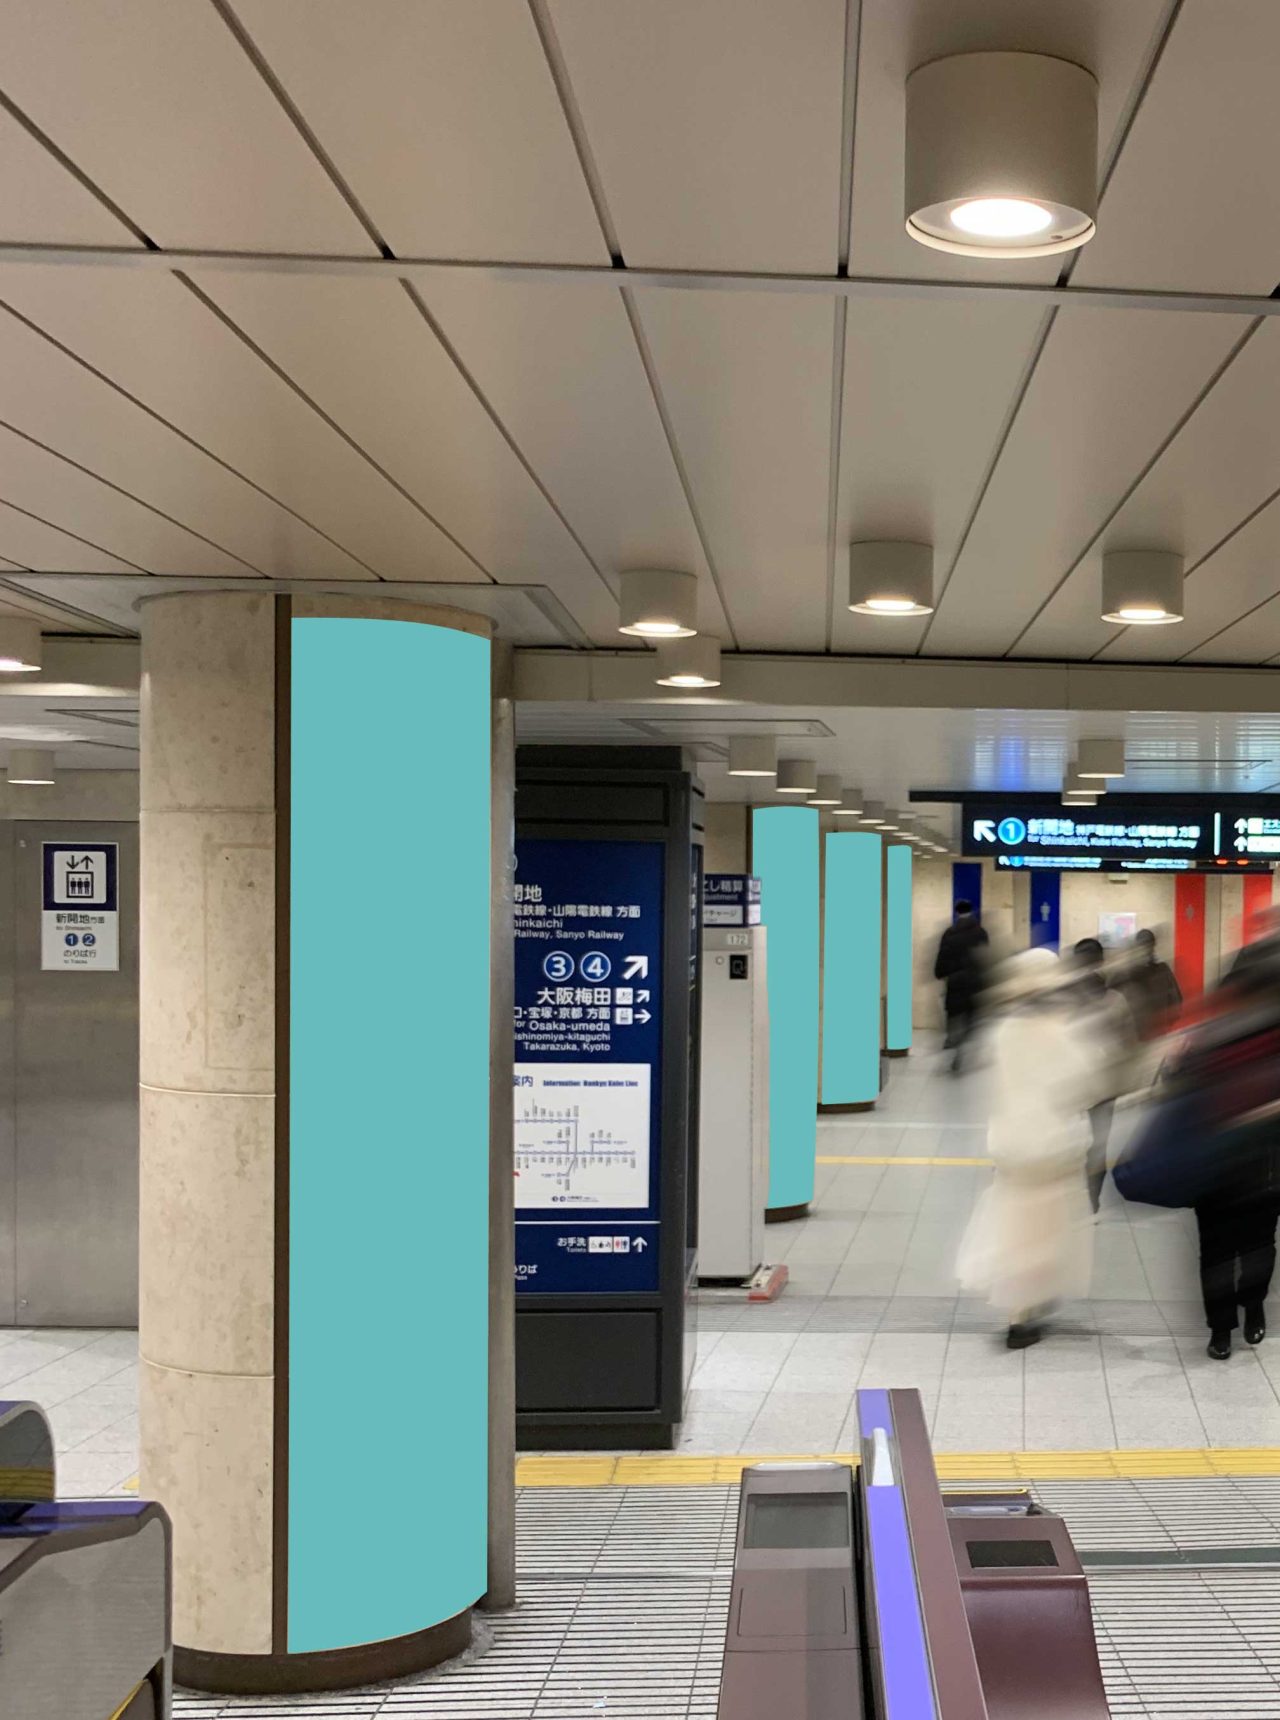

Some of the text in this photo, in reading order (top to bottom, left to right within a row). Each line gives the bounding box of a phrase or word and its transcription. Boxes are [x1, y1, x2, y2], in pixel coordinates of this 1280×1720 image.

[616, 905, 641, 918] 方面
[514, 930, 625, 941] Railway, Sanyo Railway
[537, 987, 611, 1006] 大阪梅田
[586, 1007, 611, 1019] 方面
[529, 1020, 611, 1031] Osaka-umeda
[524, 1042, 611, 1053] Takarazuka, Kyoto
